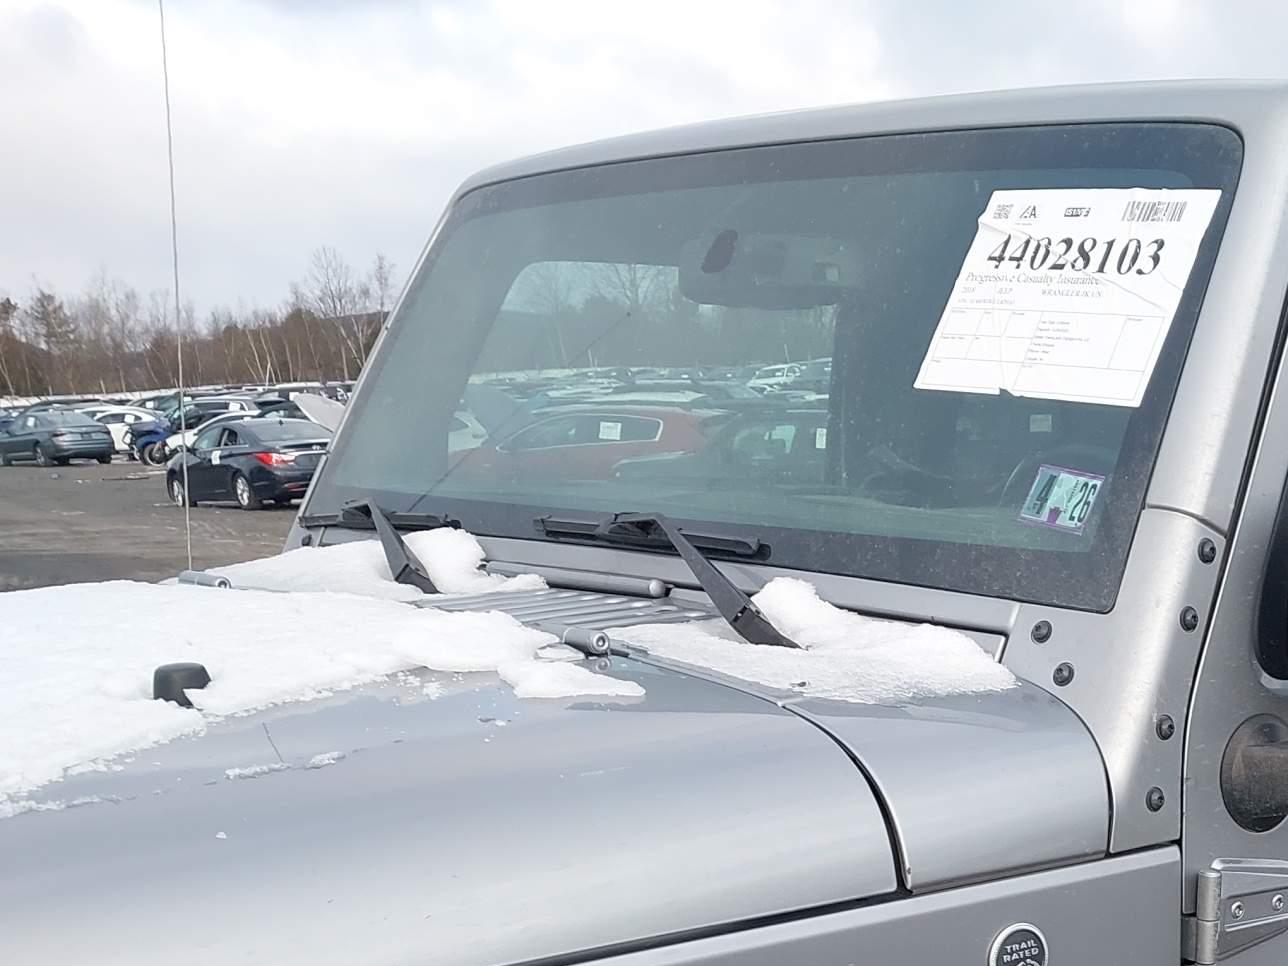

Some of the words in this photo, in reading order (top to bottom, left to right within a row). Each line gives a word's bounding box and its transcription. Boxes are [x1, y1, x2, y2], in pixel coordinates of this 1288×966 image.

[986, 232, 1166, 276] 44028103
[1016, 272, 1055, 287] Casualty
[1056, 273, 1101, 286] Insurance
[1069, 482, 1098, 522] 26
[1002, 946, 1040, 964] RATED
[1003, 938, 1038, 954] TRAIL
